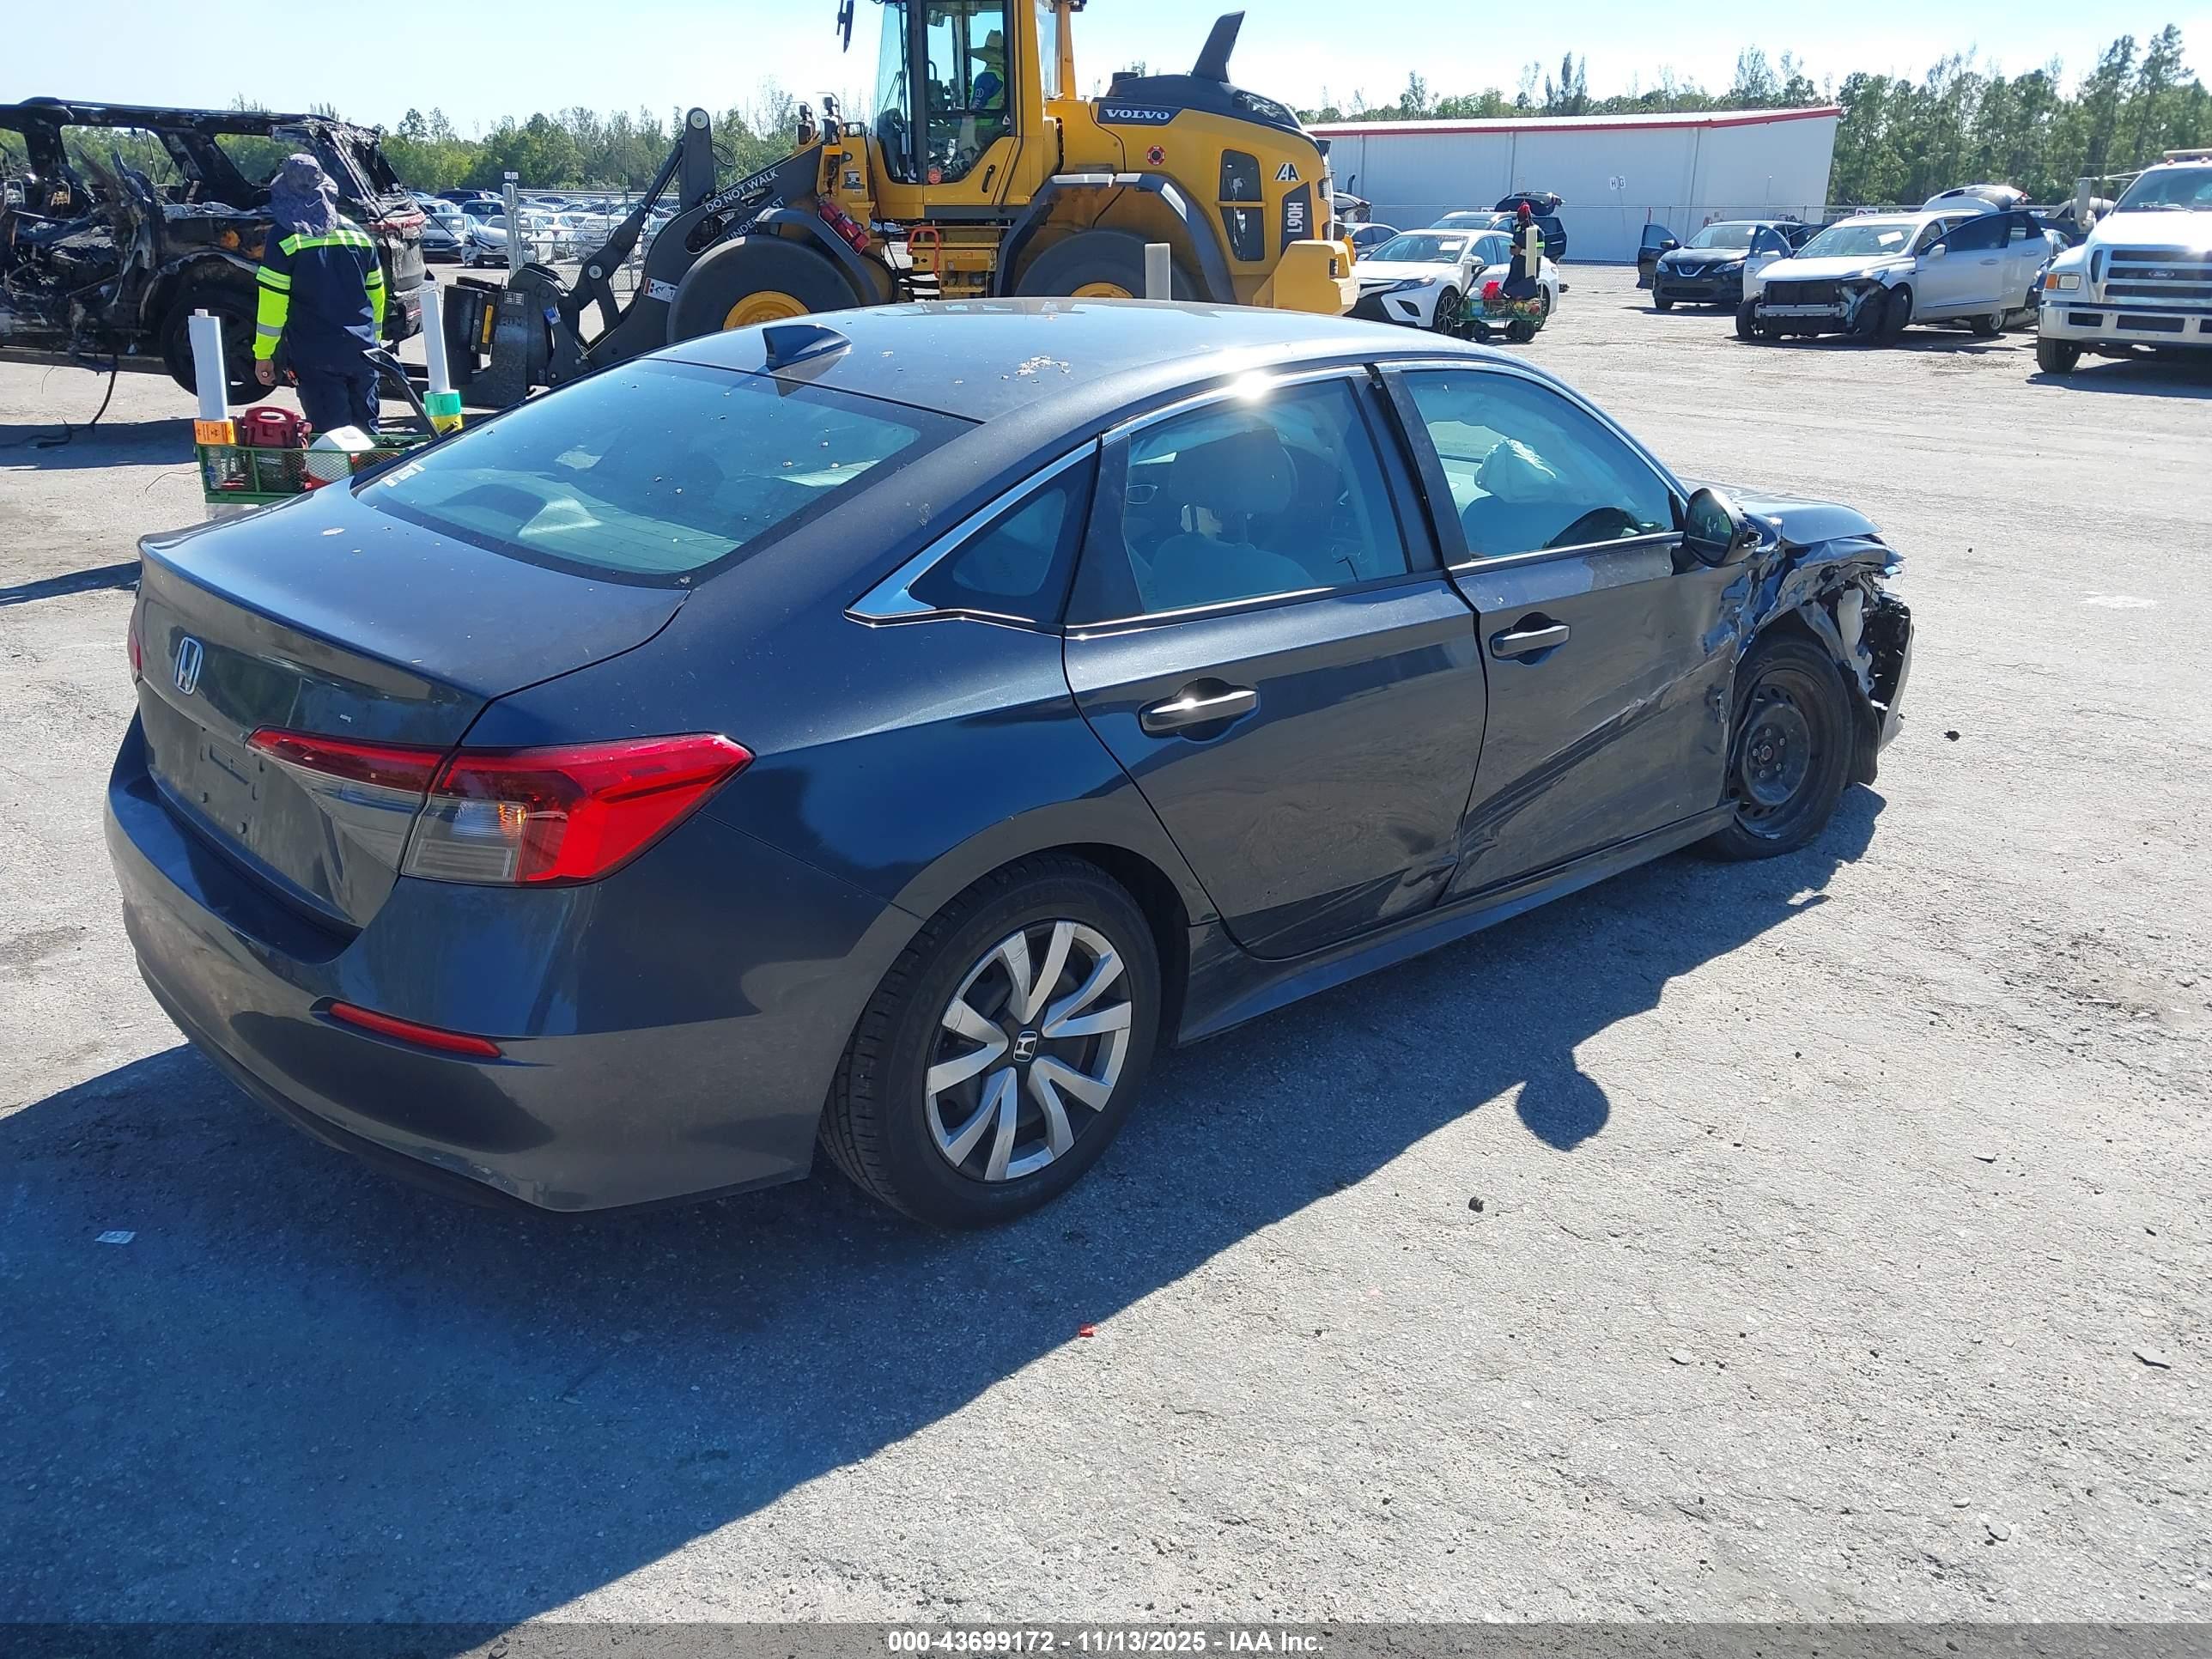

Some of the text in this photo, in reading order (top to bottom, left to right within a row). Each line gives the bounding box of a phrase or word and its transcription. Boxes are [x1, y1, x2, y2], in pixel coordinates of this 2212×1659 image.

[1105, 108, 1170, 120] VOLVO
[705, 169, 780, 213] DO NOT WALK
[1287, 202, 1304, 233] L90H
